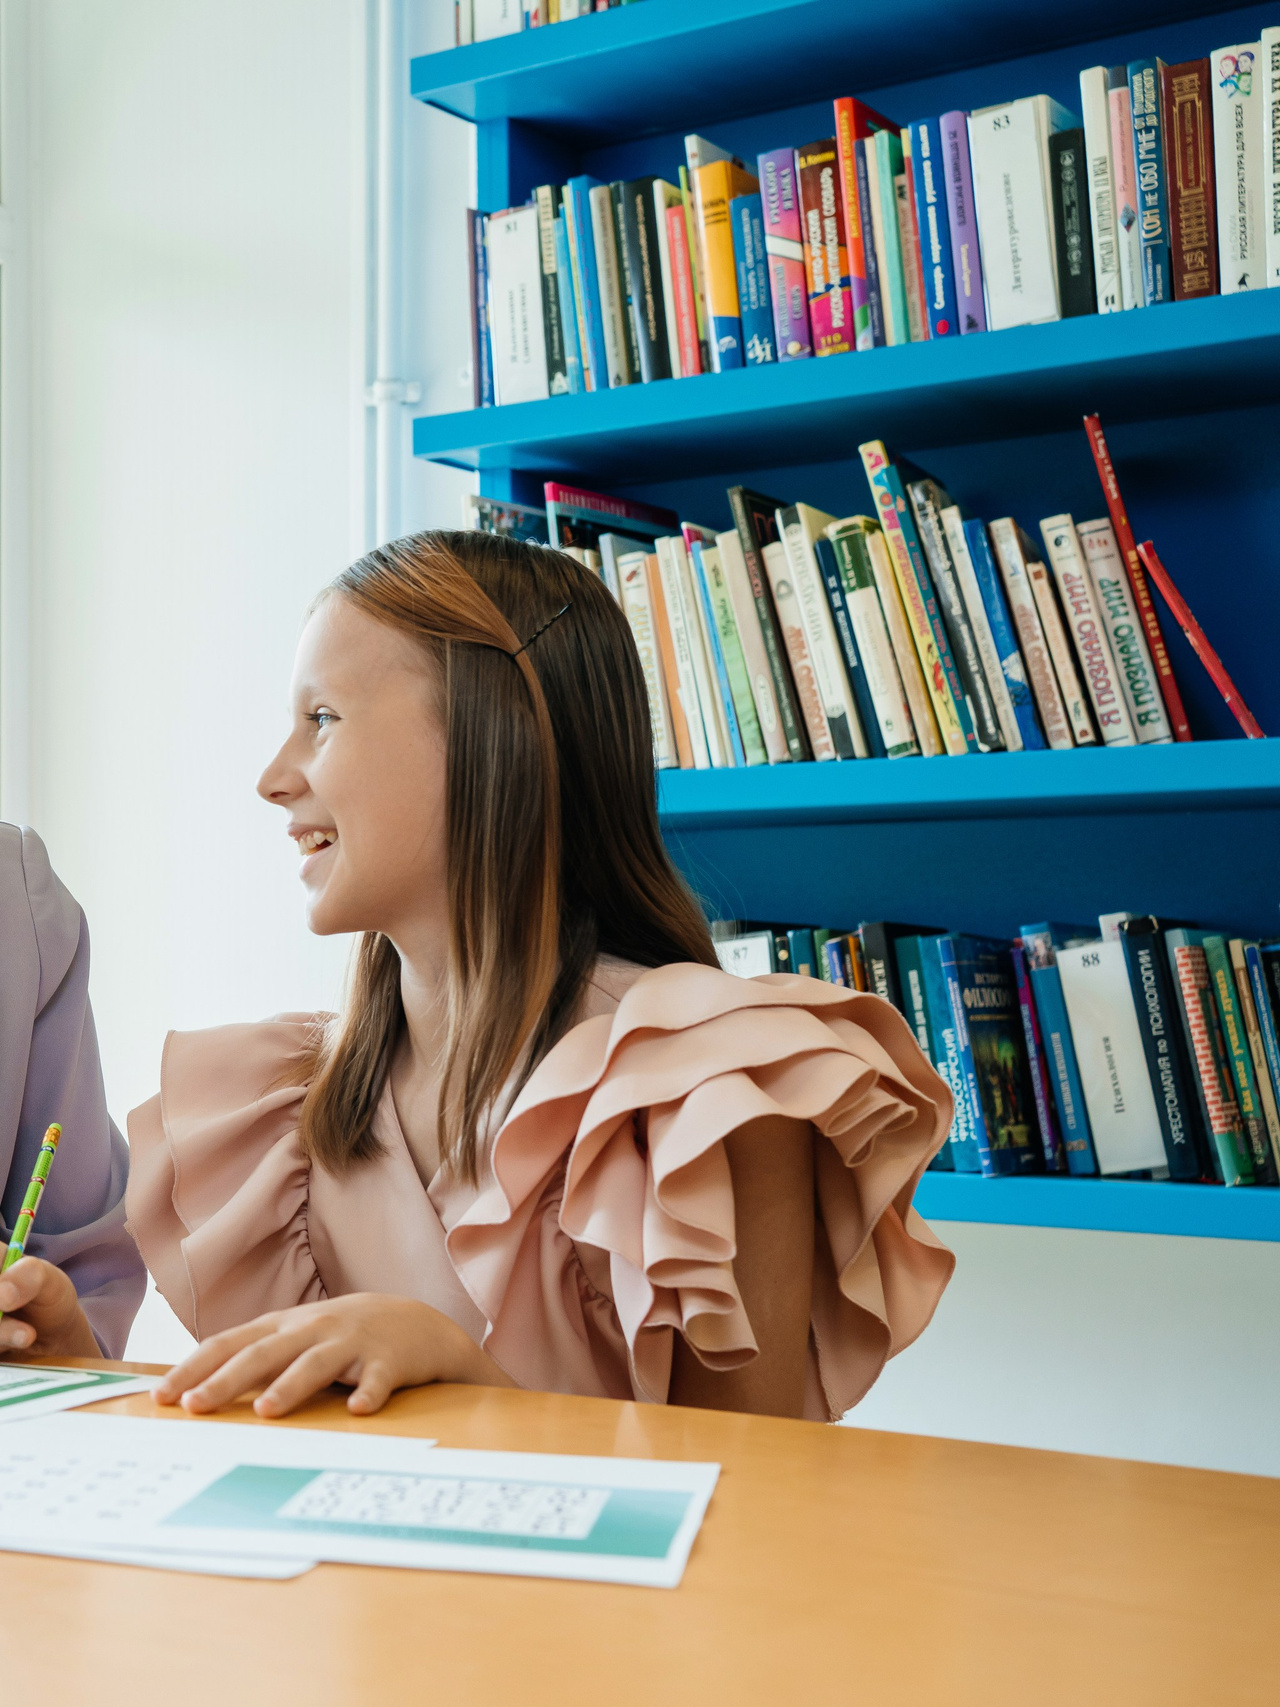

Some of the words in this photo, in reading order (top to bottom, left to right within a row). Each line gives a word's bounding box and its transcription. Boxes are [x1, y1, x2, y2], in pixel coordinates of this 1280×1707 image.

[993, 114, 1011, 130] 83
[1234, 103, 1244, 129] ВСЕХ
[1235, 130, 1245, 151] ДЛЯ
[820, 167, 835, 216] СЛОВАРЬ
[1140, 162, 1158, 191] ОБО
[1236, 152, 1247, 215] ЛИТЕРАТУРА
[1002, 172, 1023, 294] Литературоведение
[1142, 209, 1162, 238] СОН
[1238, 216, 1248, 260] РУССКАЯ
[890, 533, 931, 637] ЭНЦИКЛОПЕДИЯ
[1062, 569, 1091, 618] МИР
[1099, 573, 1130, 621] МИР
[1127, 549, 1151, 608] МУЗЫКА
[1145, 612, 1160, 638] БЕЗ
[1154, 642, 1171, 676] ТАЙН
[1075, 618, 1116, 707] ПОЗНАЮ
[1112, 622, 1154, 708] ПОЗНАЮ
[1100, 709, 1121, 728] Я
[1137, 708, 1160, 727] Я
[1082, 951, 1099, 967] 88
[1138, 949, 1165, 1036] ПСИХОЛОГИИ
[1158, 1039, 1168, 1053] по
[941, 1028, 970, 1142] ФИЛОСОФСКИЙ
[1102, 1035, 1125, 1113] Психология
[1235, 1059, 1248, 1088] мозг
[1158, 1056, 1185, 1145] ХРЕСТОМАТИЯ
[1241, 1089, 1254, 1112] Как
